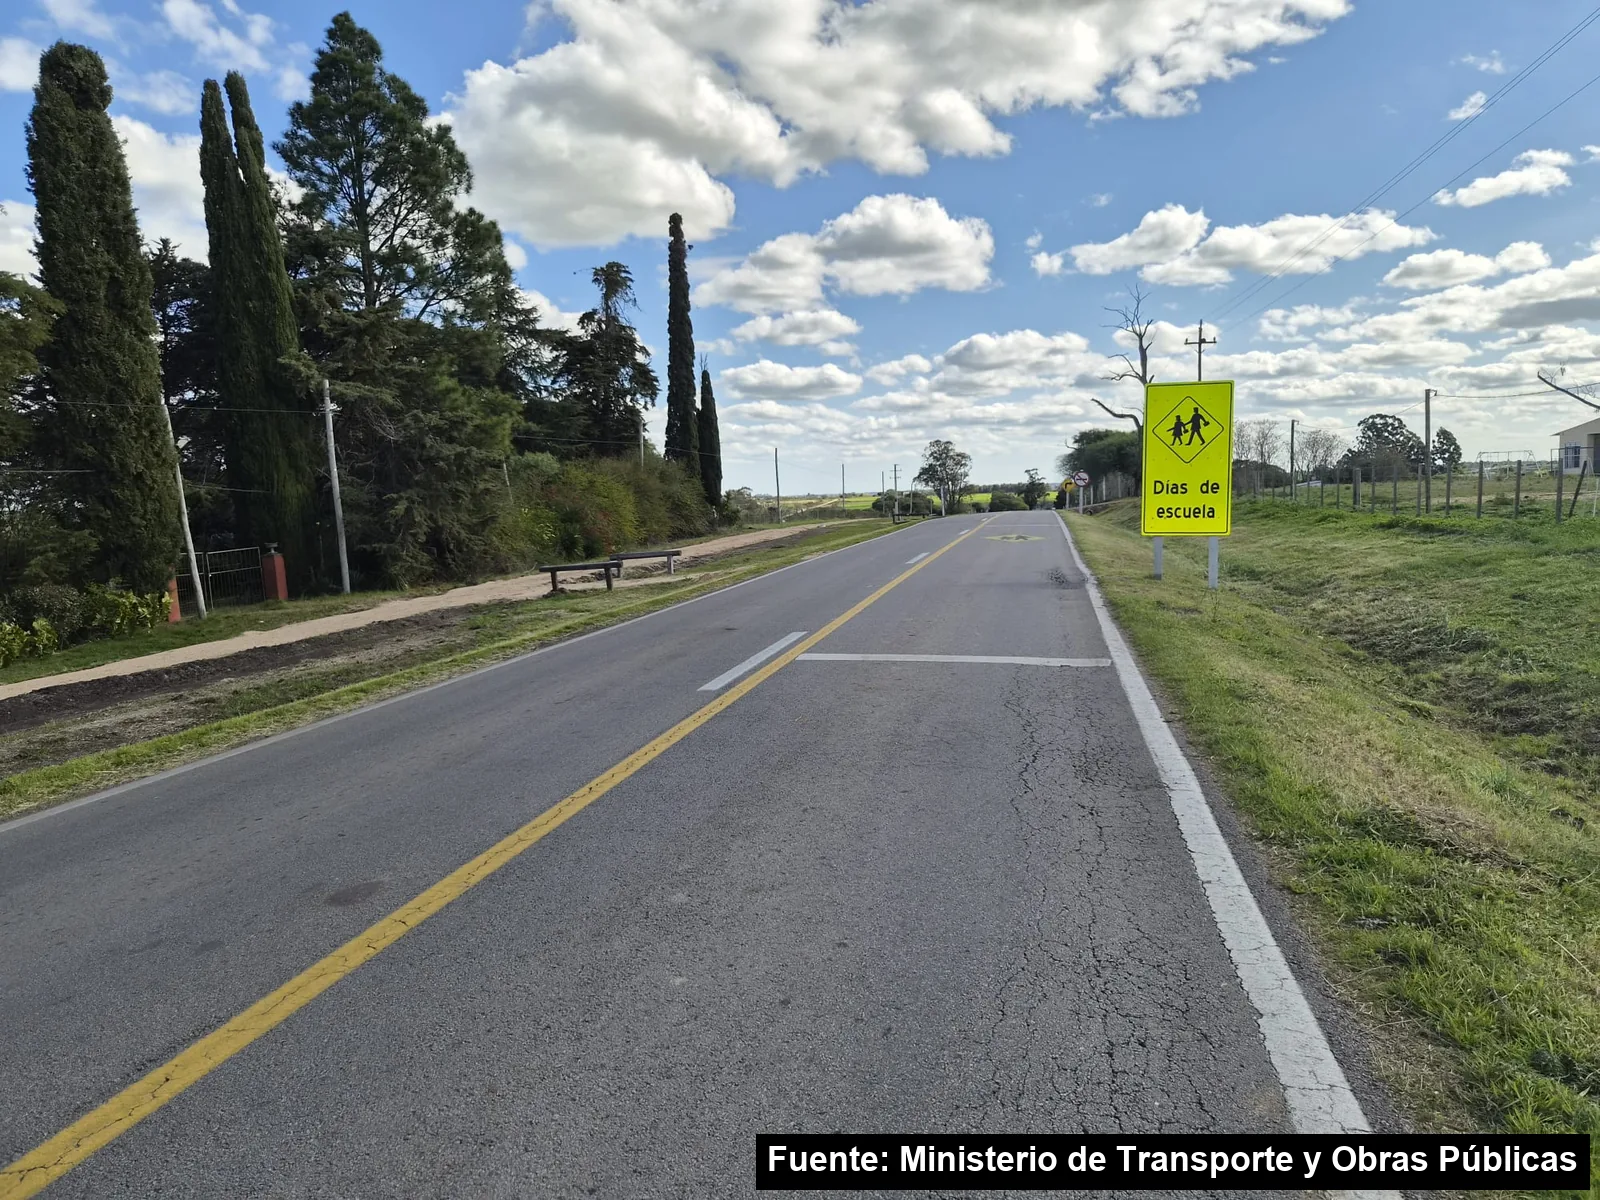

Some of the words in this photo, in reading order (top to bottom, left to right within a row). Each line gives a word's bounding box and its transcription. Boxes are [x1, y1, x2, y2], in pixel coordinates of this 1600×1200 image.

[1153, 479, 1188, 494] Días
[1200, 479, 1220, 494] de
[1156, 504, 1215, 519] escuela
